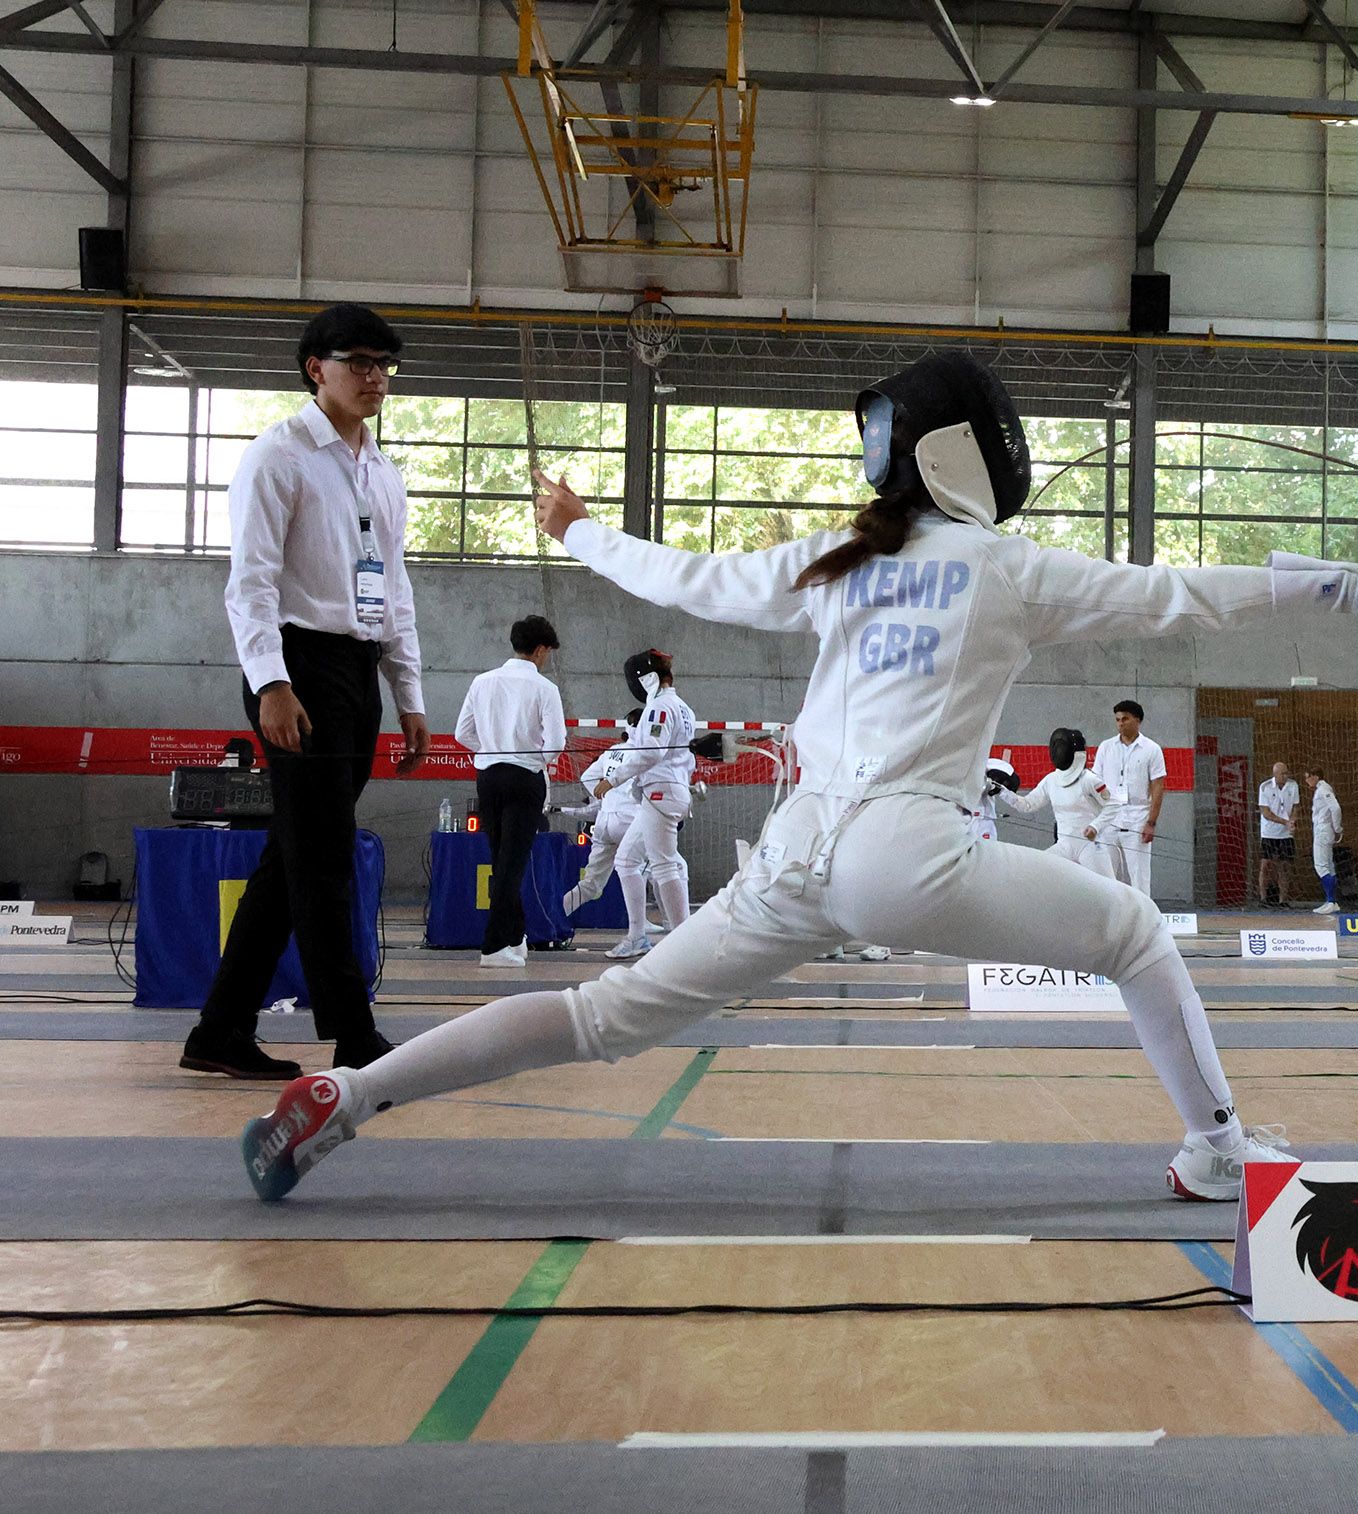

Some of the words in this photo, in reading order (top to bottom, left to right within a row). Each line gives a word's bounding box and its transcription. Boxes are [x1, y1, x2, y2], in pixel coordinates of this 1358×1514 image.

[845, 560, 970, 610] KEMP
[858, 622, 941, 677] GBR
[1221, 759, 1245, 817] SALA
[468, 817, 477, 832] 0
[578, 834, 585, 845] 0
[10, 925, 67, 935] Pontevedra
[1284, 945, 1328, 953] Pontevedra
